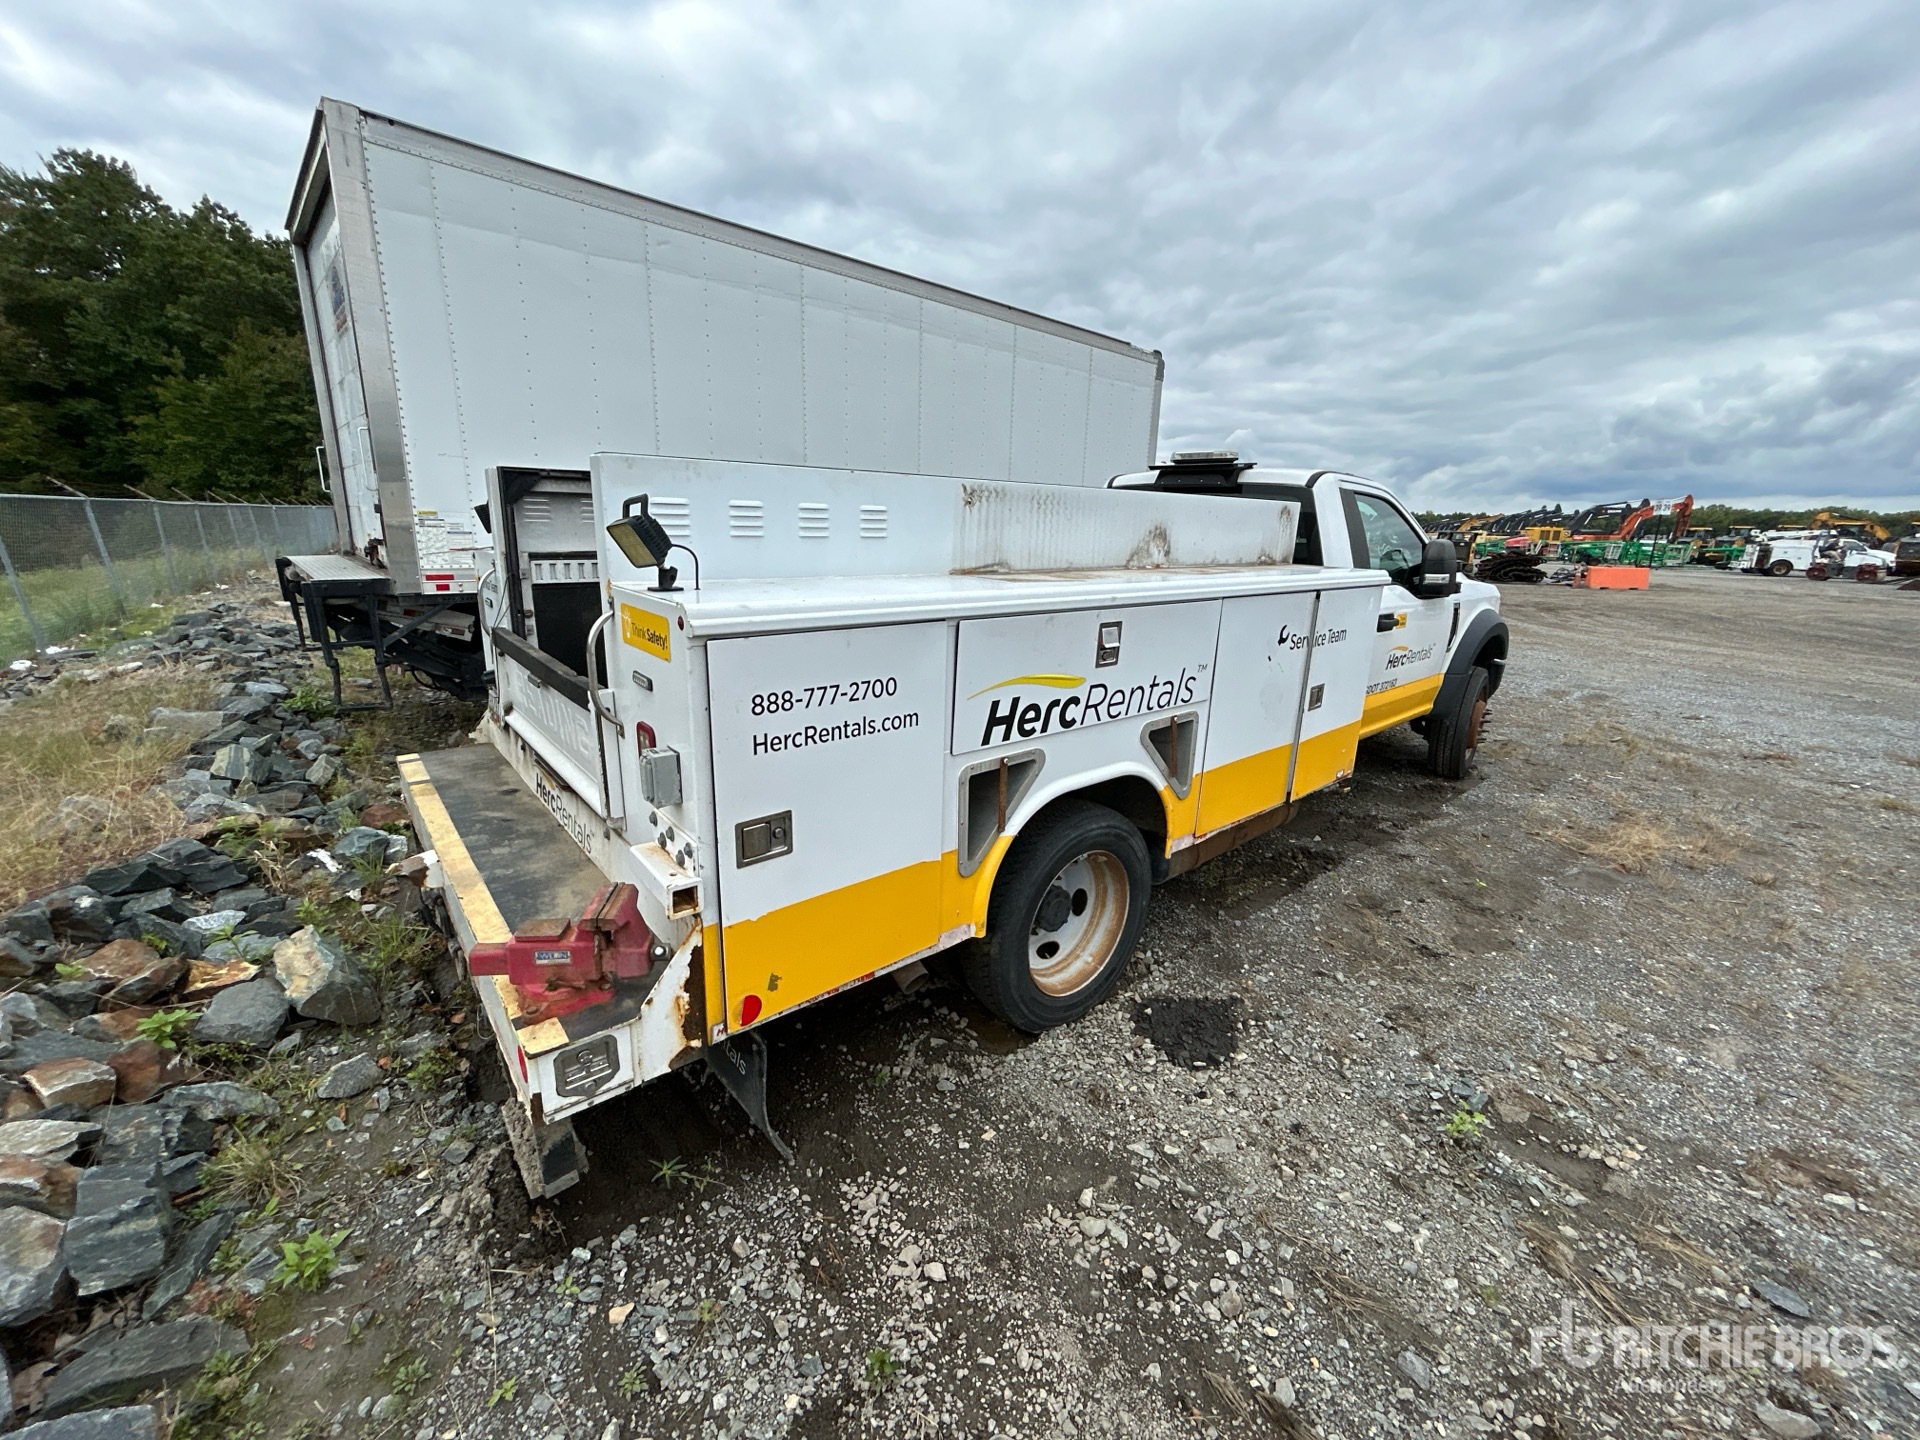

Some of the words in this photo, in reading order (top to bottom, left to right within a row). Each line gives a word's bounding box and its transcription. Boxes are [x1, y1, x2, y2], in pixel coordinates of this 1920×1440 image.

[646, 628, 668, 650] Safety!
[1327, 628, 1347, 645] Team
[1385, 644, 1433, 670] HercRentals
[751, 676, 898, 716] 888-777-2700
[980, 667, 1197, 747] HercRentals
[752, 711, 919, 756] HercRentals.com
[536, 772, 592, 854] HercRentals
